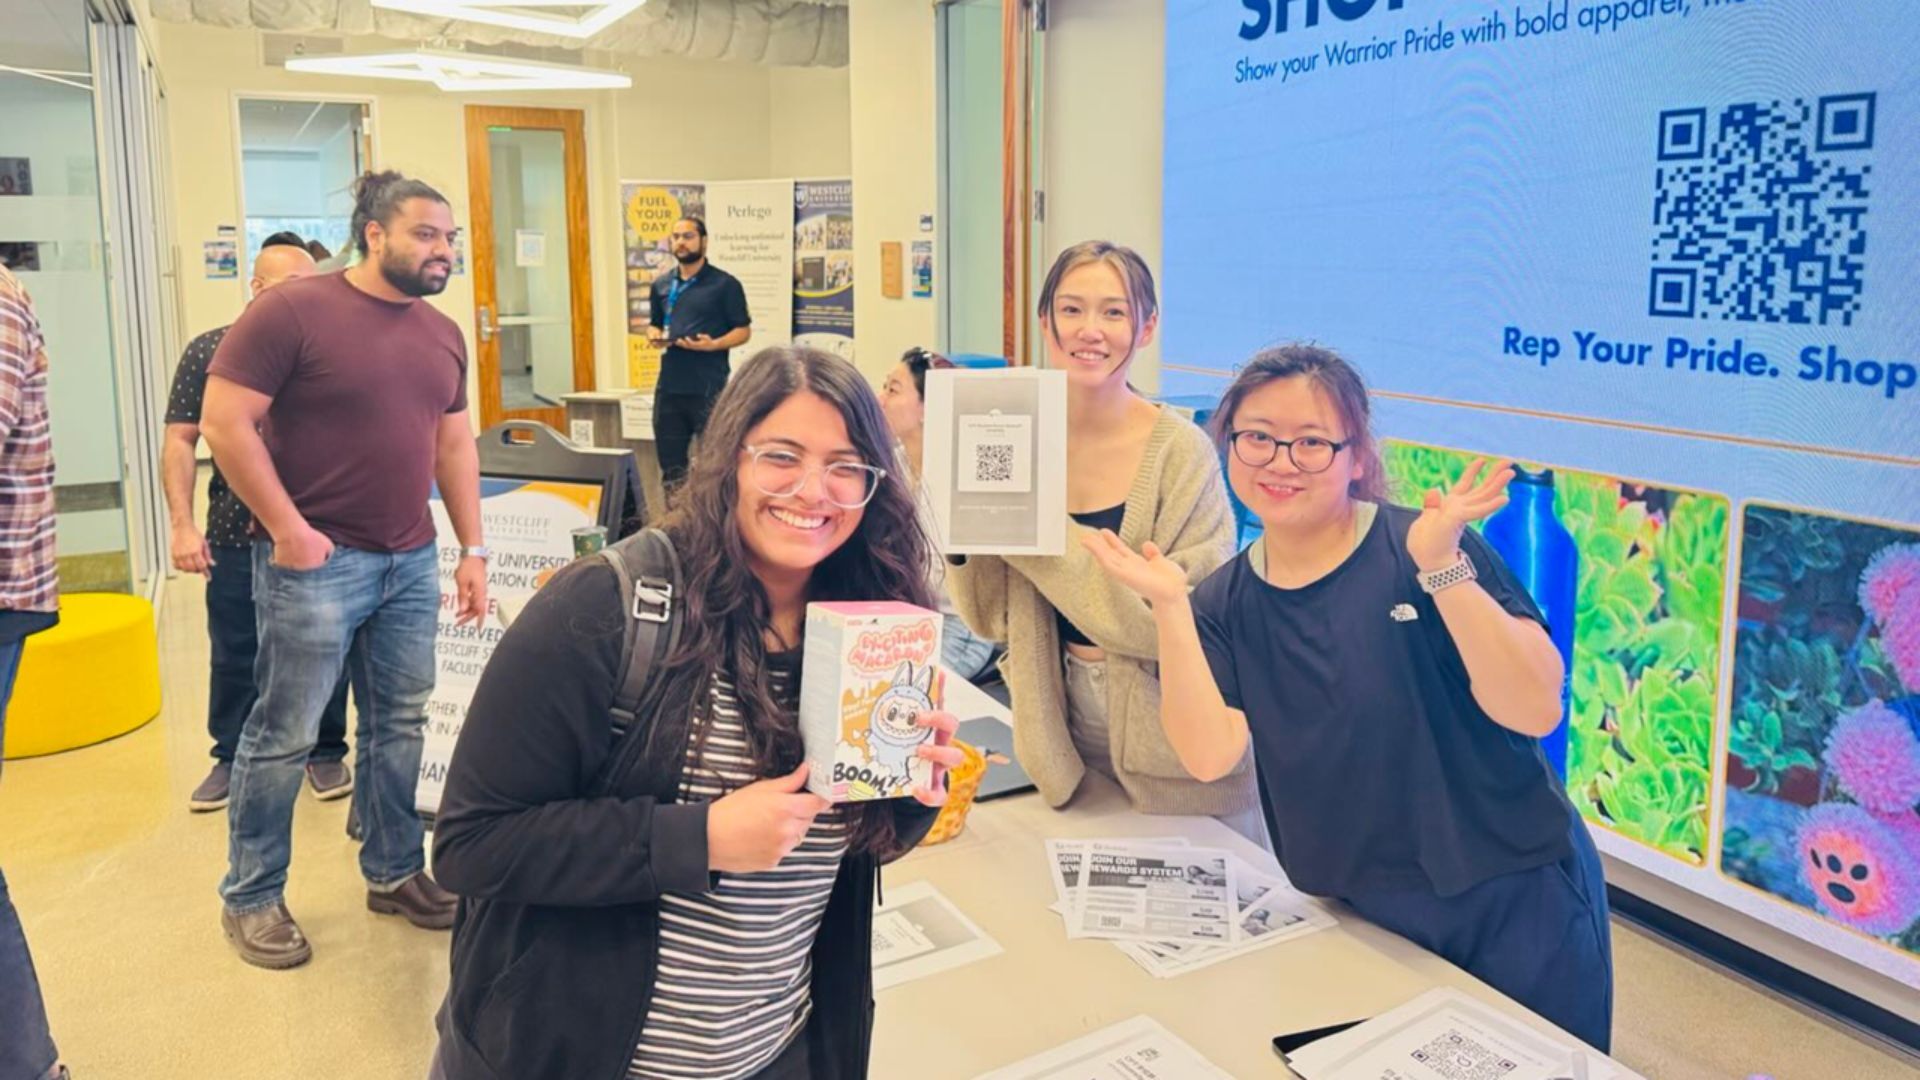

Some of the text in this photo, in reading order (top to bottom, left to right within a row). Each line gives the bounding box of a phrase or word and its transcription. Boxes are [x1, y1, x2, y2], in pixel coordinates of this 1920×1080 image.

[1235, 56, 1278, 84] Show
[1281, 53, 1320, 83] your
[1324, 36, 1397, 67] Warrior
[1404, 20, 1455, 56] Pride
[1461, 10, 1506, 45] with
[1514, 0, 1568, 38] bold
[639, 196, 668, 207] FUEL
[635, 209, 672, 220] YOUR
[727, 204, 772, 220] Perlego
[640, 222, 668, 232] DAY
[1502, 326, 1918, 399] Rep Your Pride. Shop
[435, 640, 480, 660] ESTCLIFF
[832, 762, 899, 797] BOOM!
[1115, 857, 1138, 866] OUR
[1140, 866, 1183, 878] SYSTEM
